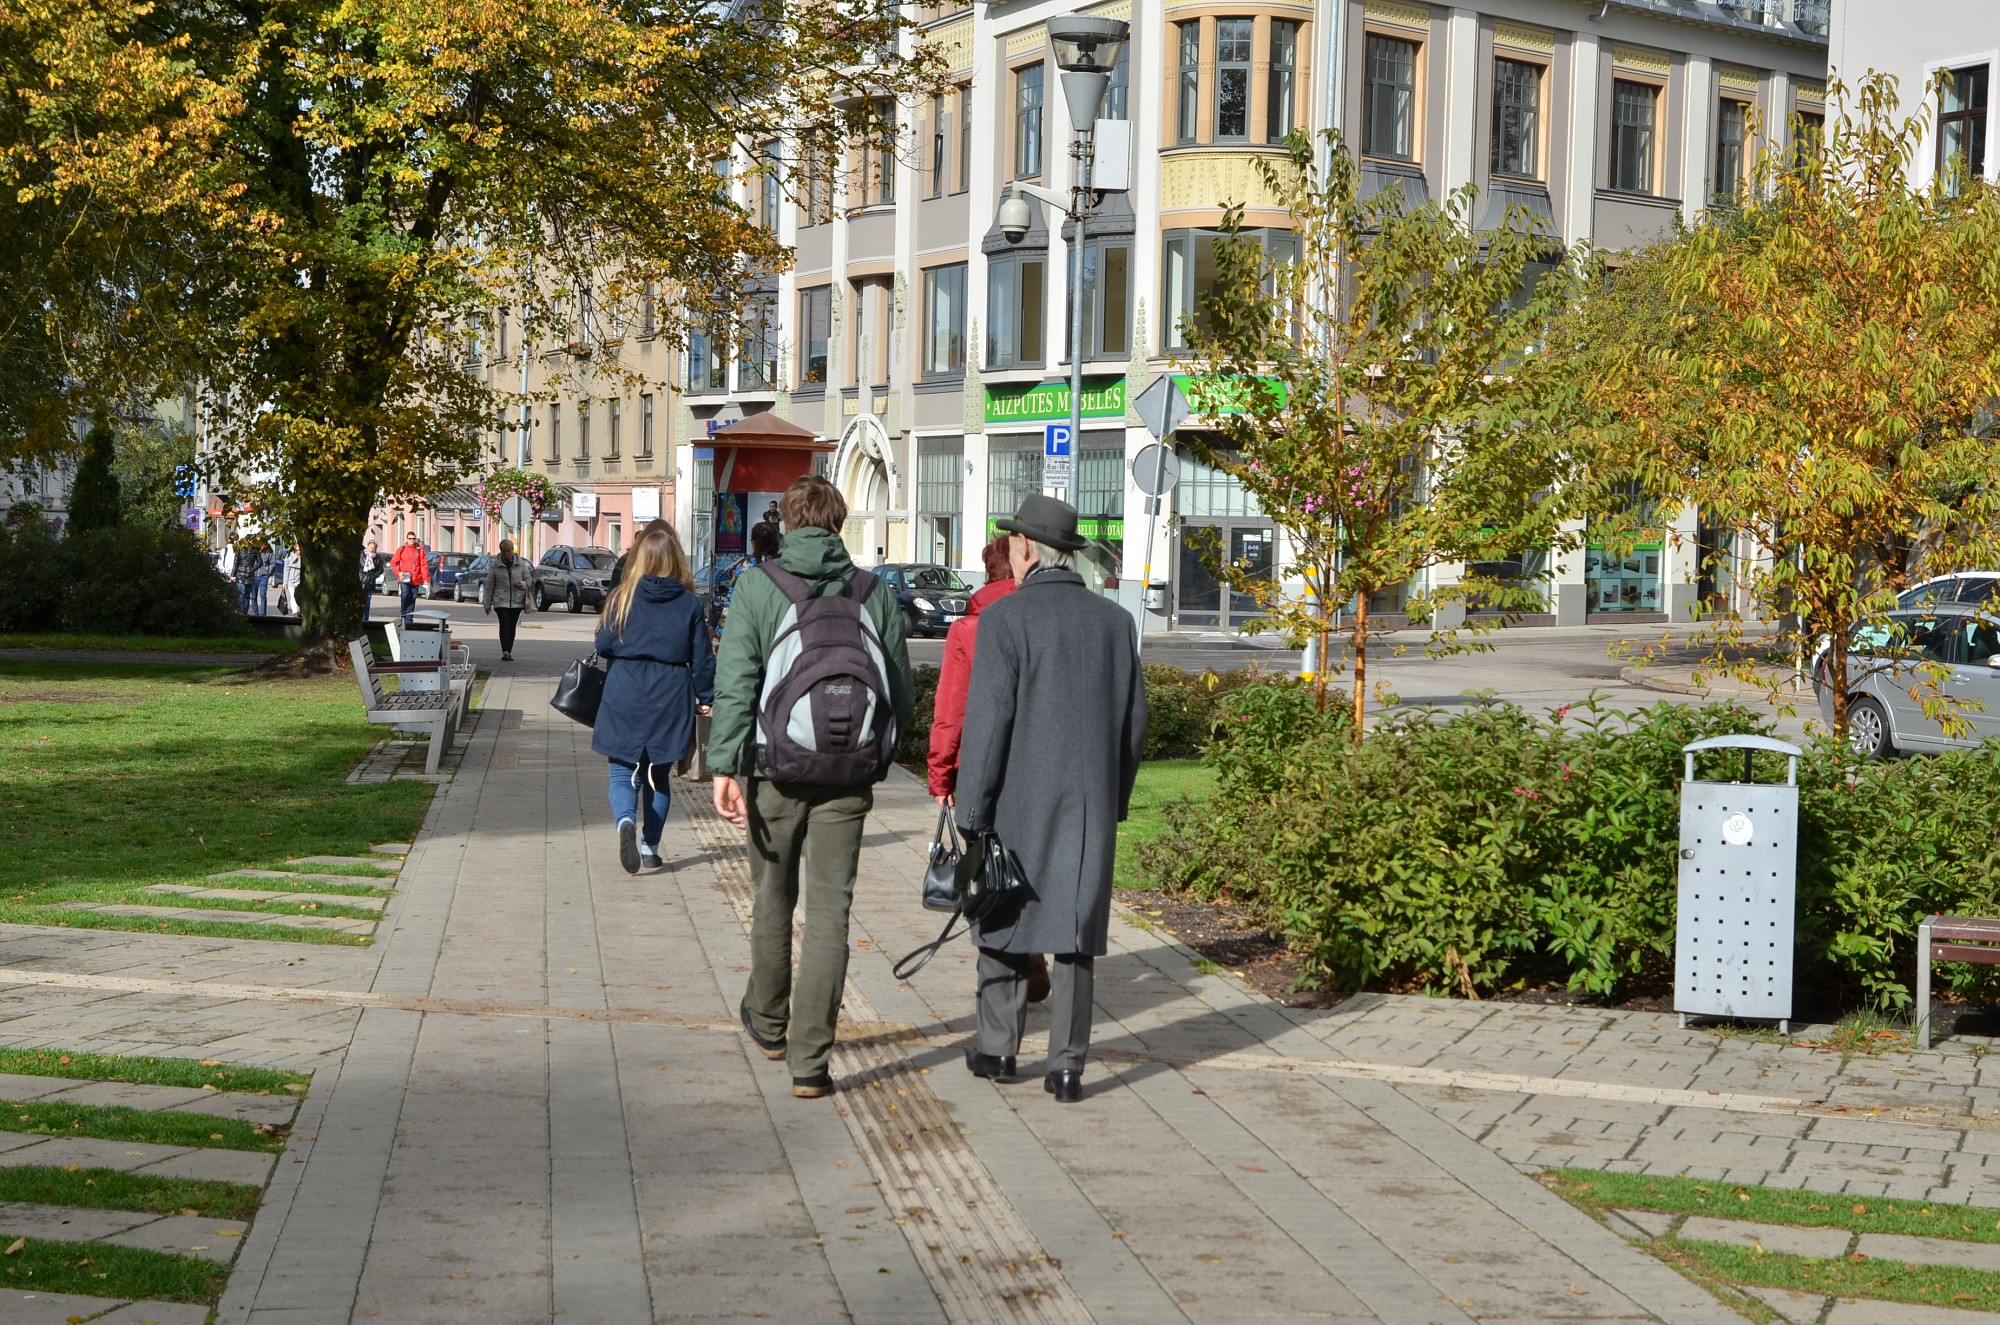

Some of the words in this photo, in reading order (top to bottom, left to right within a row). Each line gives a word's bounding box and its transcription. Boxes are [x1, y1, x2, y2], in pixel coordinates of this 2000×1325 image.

[992, 392, 1053, 415] AIZPUTES
[1057, 387, 1121, 412] MBELES
[1053, 428, 1070, 453] P
[474, 508, 482, 519] P
[1077, 524, 1094, 538] BEĻU
